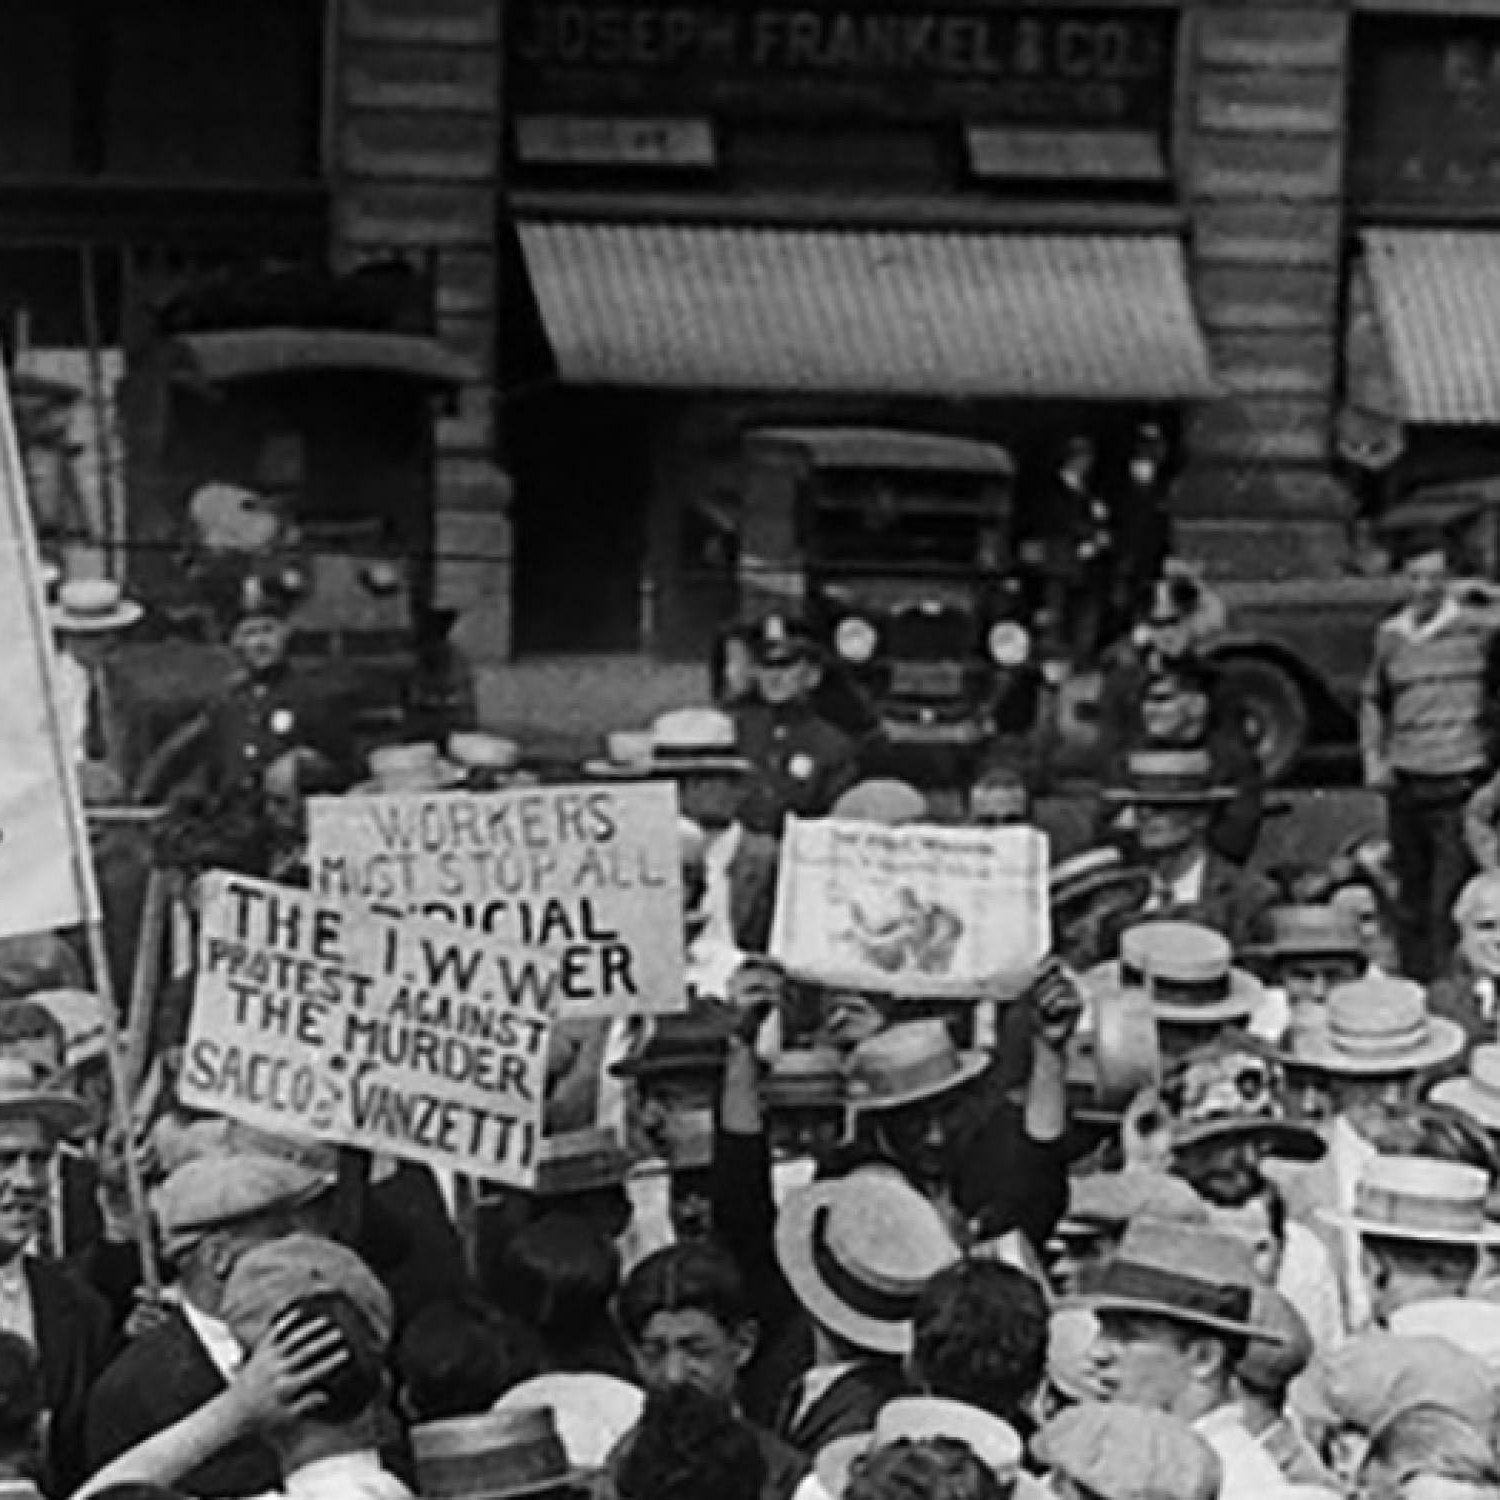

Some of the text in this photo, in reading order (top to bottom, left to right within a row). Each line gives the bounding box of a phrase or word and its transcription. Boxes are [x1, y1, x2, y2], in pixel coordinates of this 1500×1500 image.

[752, 10, 999, 74] FRANKEL
[370, 791, 617, 850] WORKERS
[320, 847, 666, 898] MUST STOP ALL
[227, 881, 344, 963] THE
[208, 936, 547, 1055] PROTEST AGAINST
[227, 980, 533, 1101] THE MURDER
[351, 1059, 534, 1168] VANZETTI
